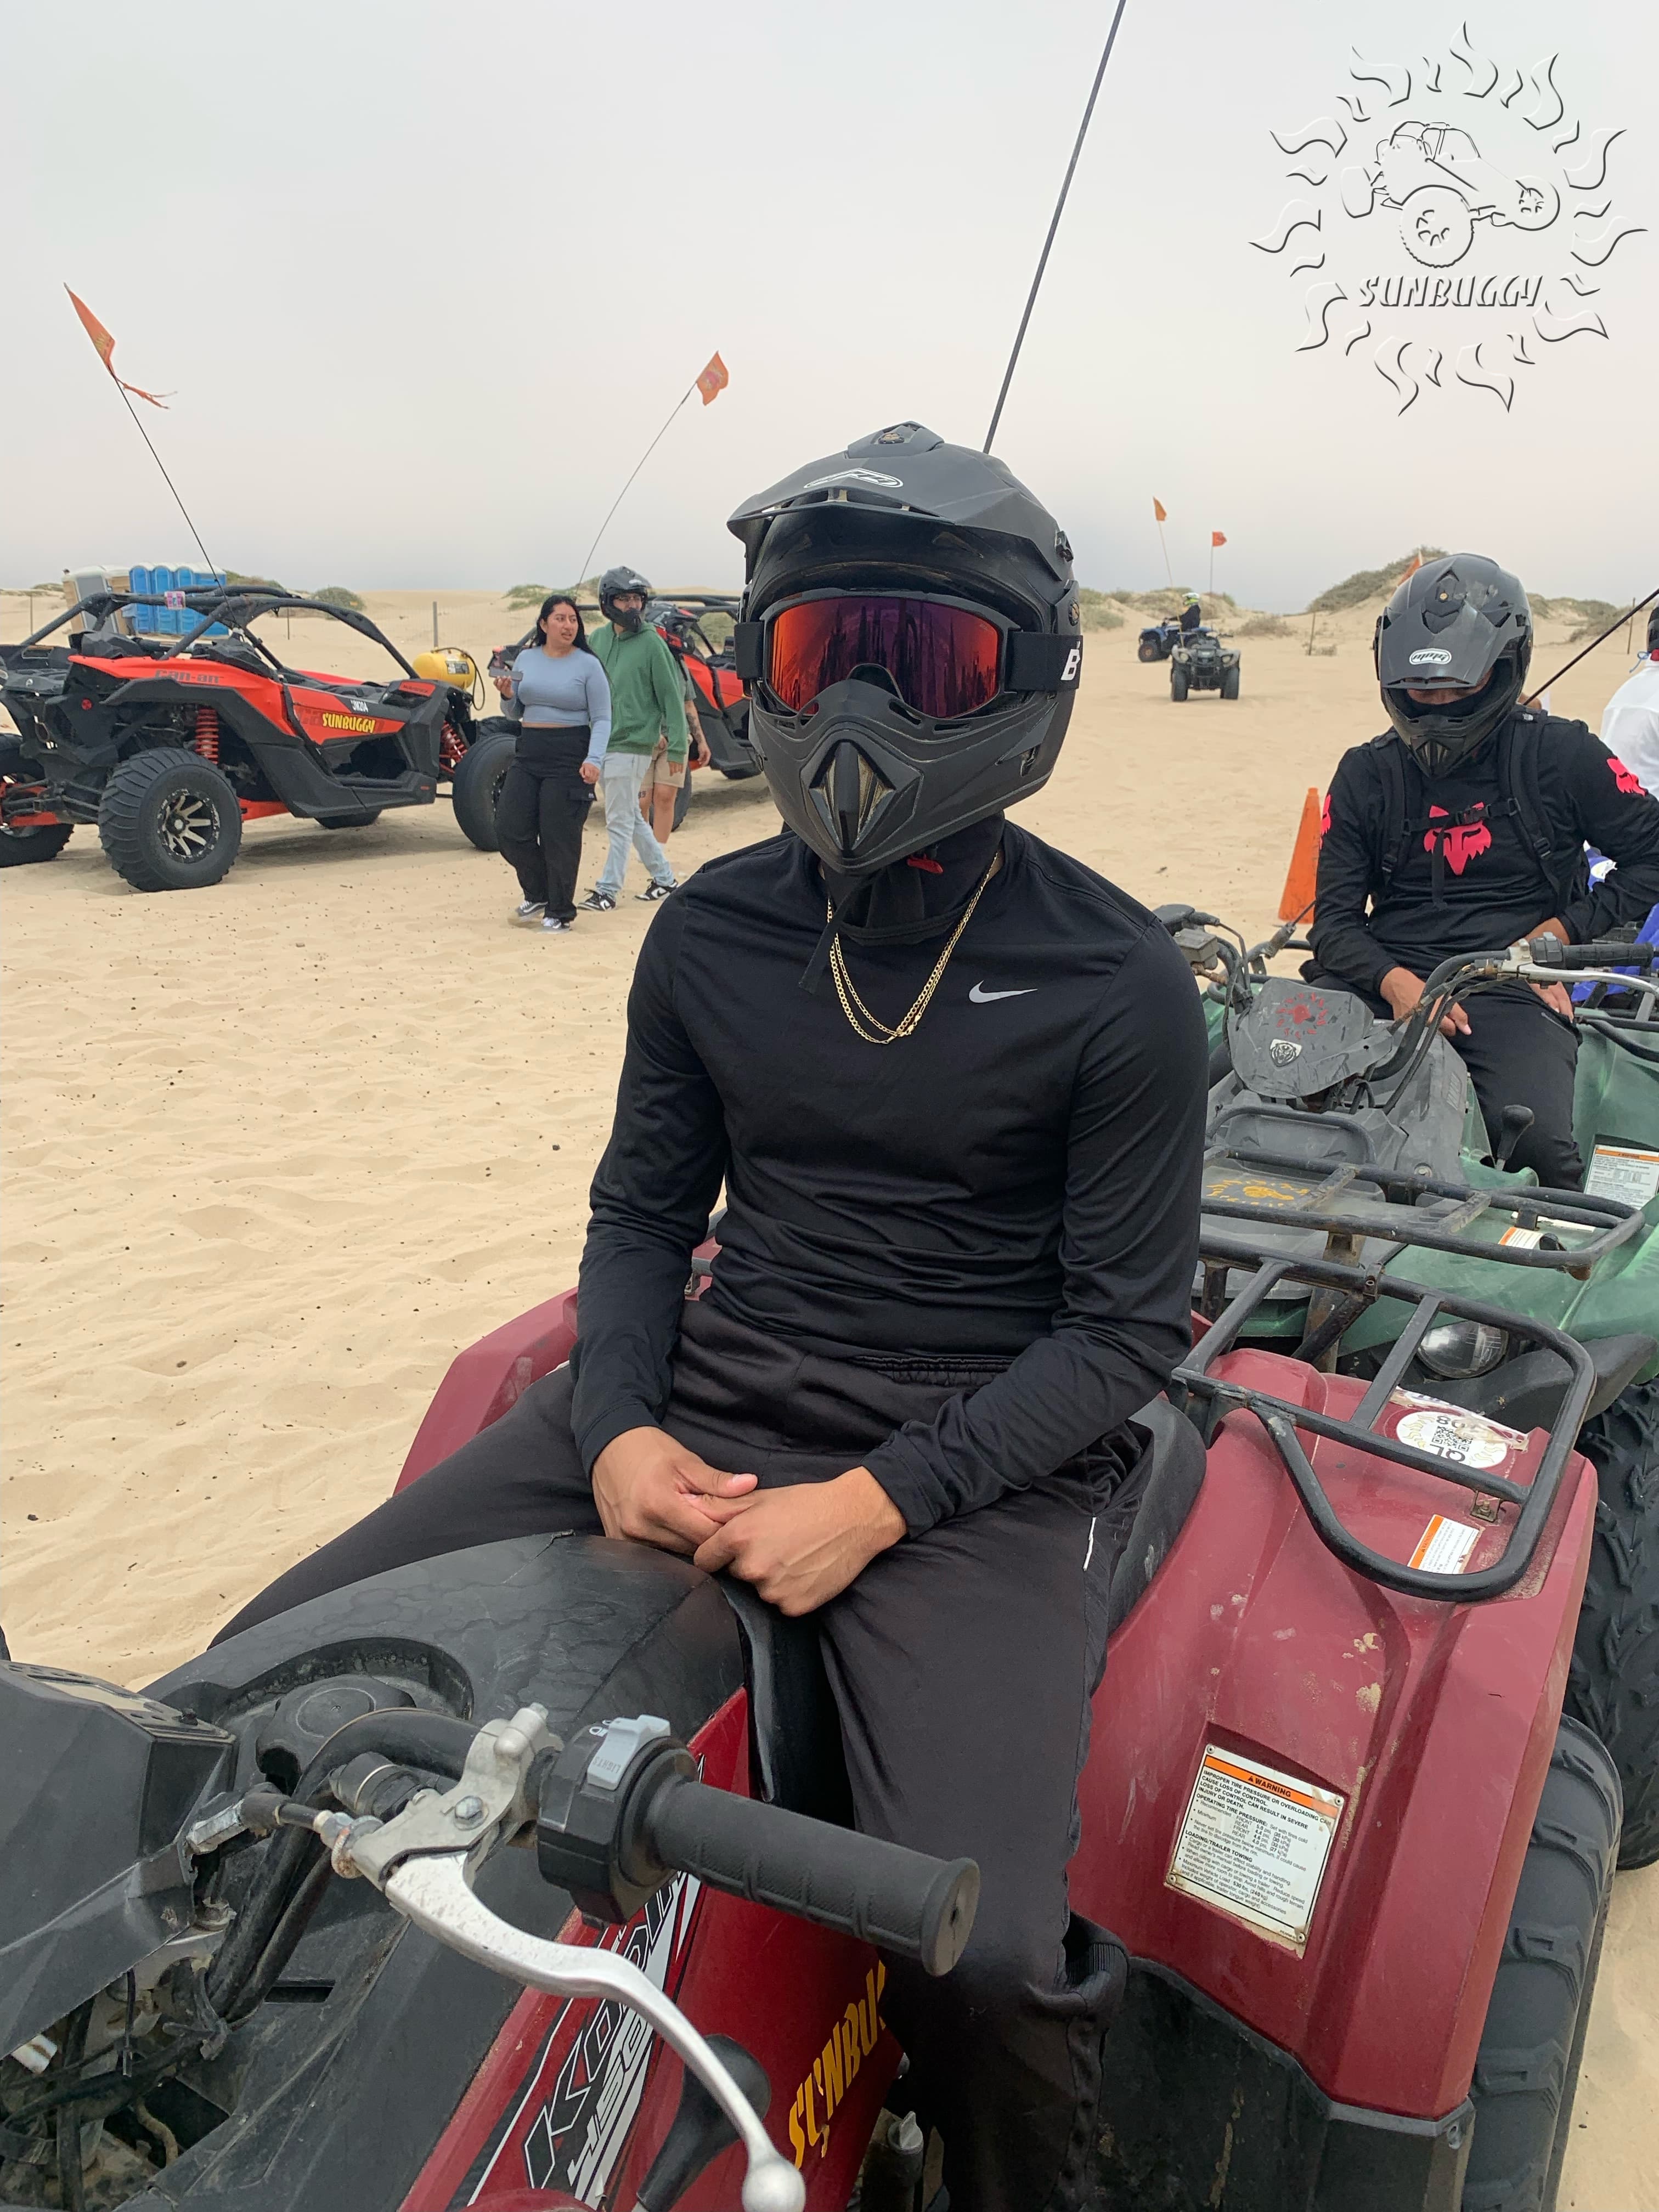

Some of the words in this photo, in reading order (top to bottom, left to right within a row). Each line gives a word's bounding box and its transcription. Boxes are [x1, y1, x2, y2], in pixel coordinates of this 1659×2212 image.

[322, 713, 376, 733] SUNBUGGY
[592, 1756, 622, 1774] LIGHTS
[1201, 1775, 1218, 1786] CAUSE
[1219, 1782, 1233, 1792] LOSS
[1242, 1792, 1268, 1806] CONTROL.
[1254, 1778, 1291, 1797] WARNING
[1196, 1793, 1225, 1808] OPERATING
[1226, 1805, 1238, 1814] TIRE
[1198, 1786, 1216, 1797] INJURY
[1226, 1798, 1244, 1809] DEATH.
[1200, 1781, 1213, 1790] LOSS
[1222, 1790, 1247, 1803] CONTROL
[1247, 1801, 1259, 1809] CAN
[1259, 1805, 1279, 1817] RESULT
[1286, 1817, 1308, 1829] SEVERE
[1203, 1769, 1230, 1784] IMPROPER
[1231, 1781, 1243, 1789] TIRE
[1243, 1786, 1271, 1801] PRESSURE
[1280, 1801, 1319, 1820] OVERLOADING
[1319, 1818, 1331, 1826] CAN
[1234, 1820, 1248, 1829] REAR
[1235, 1815, 1252, 1825] FRONT
[1232, 1830, 1245, 1838] REAR
[1233, 1825, 1249, 1835] FRONT
[1231, 1849, 1252, 1862] TOWING
[567, 2013, 654, 2186] 450
